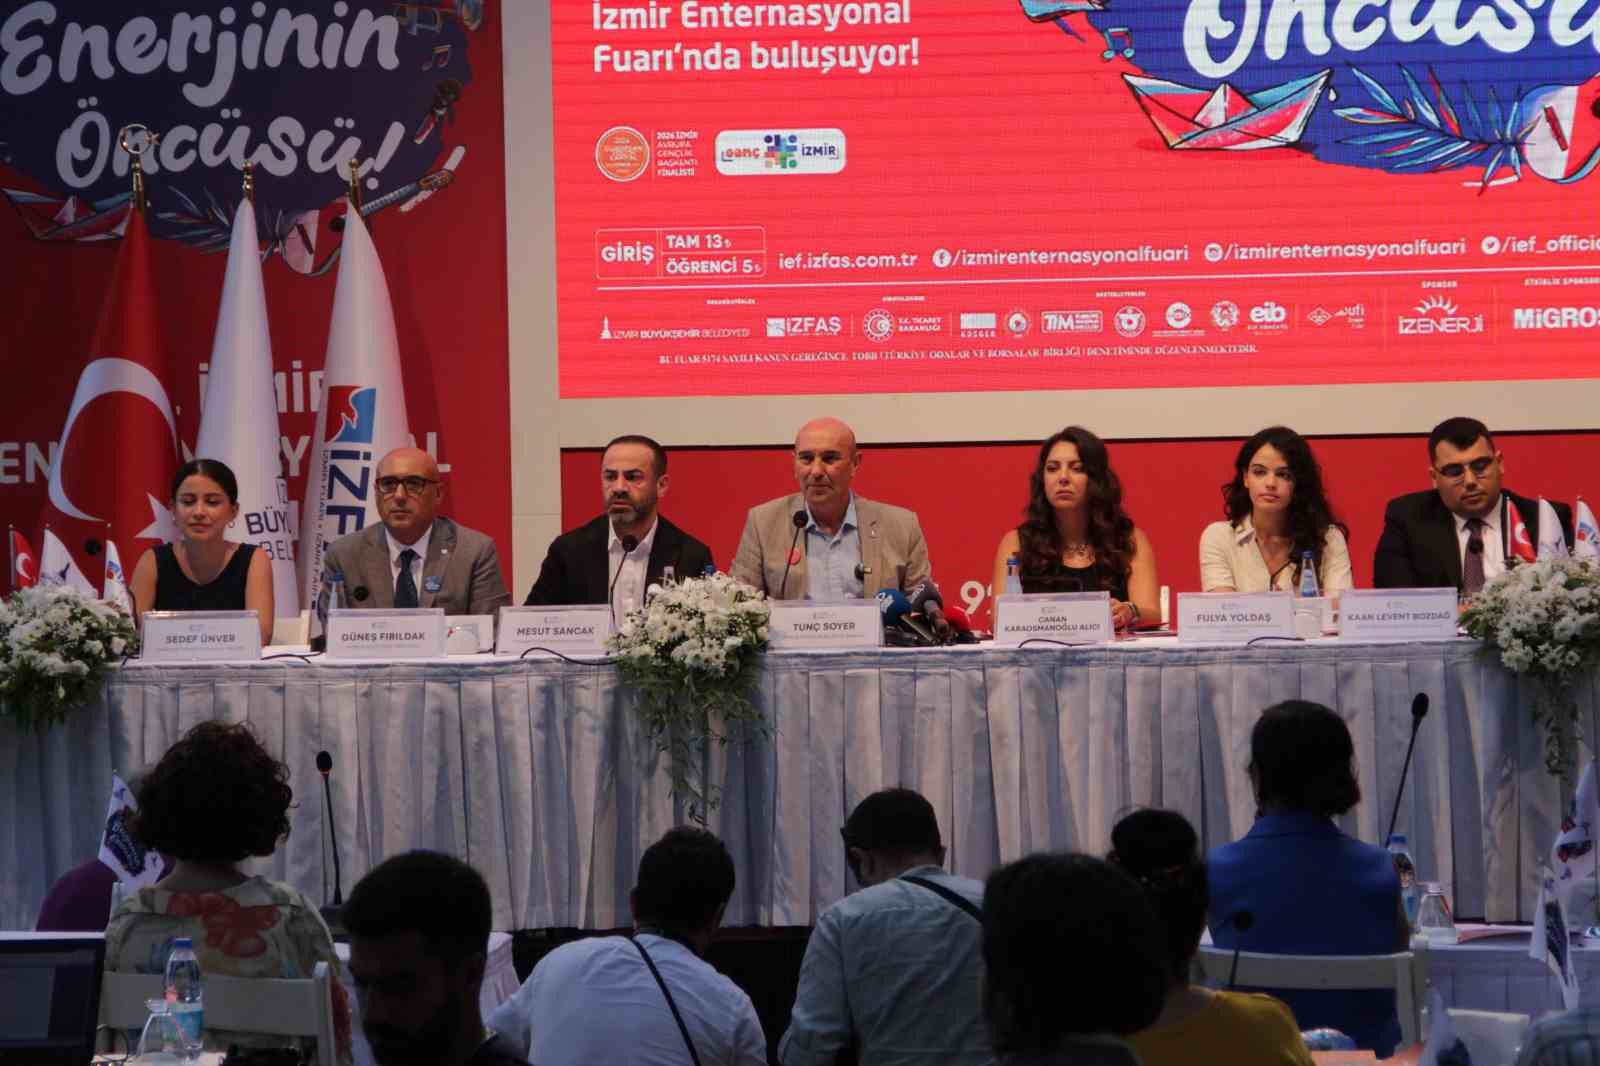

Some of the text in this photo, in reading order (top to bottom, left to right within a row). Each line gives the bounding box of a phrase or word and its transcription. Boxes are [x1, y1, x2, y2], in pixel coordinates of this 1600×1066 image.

[681, 0, 910, 32] Enternasyonal
[0, 1, 400, 107] Enerjinin
[751, 38, 919, 74] buluşuyor!
[56, 96, 406, 190] Öncüsü!
[801, 143, 836, 156] İZMİR
[666, 235, 700, 249] TAM
[601, 242, 655, 265] GİRİŞ
[778, 251, 918, 270] ief.izfas.com.tr
[666, 257, 737, 274] ÖĞRENCİ
[786, 316, 842, 335] İZFAŞ
[1513, 306, 1600, 330] MiGRO
[793, 621, 855, 632] TUNÇ SOYER
[341, 631, 377, 643] GÜNEŞ
